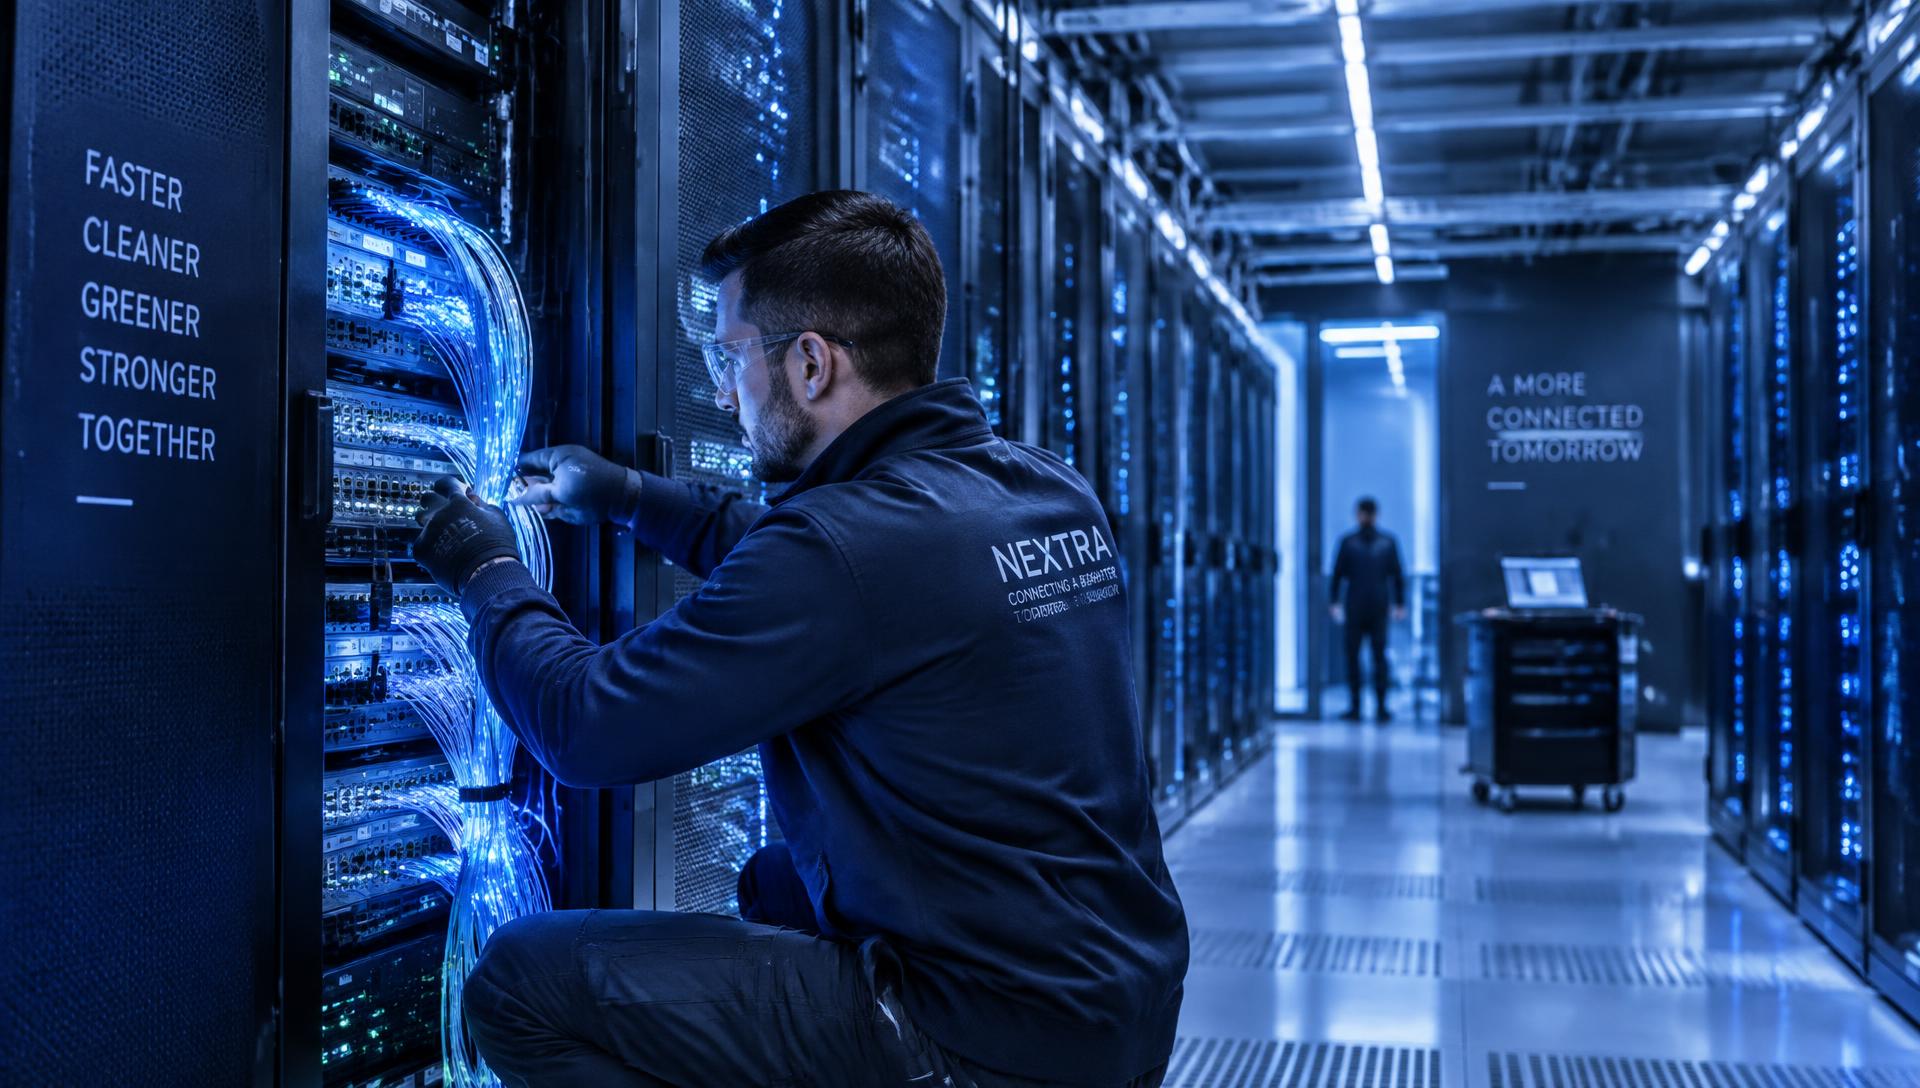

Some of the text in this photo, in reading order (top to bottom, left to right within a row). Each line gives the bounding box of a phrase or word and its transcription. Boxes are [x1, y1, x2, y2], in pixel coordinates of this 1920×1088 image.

[86, 149, 182, 212] FASTER
[83, 216, 200, 278] CLEANER
[81, 281, 200, 338] GREENER
[79, 346, 216, 400] STRONGER
[1487, 372, 1586, 397] A MORE
[78, 412, 215, 462] TOGETHER
[1487, 405, 1643, 430] CONNECTED
[1488, 438, 1643, 463] TOMORROW
[991, 526, 1112, 582] NEXTRA
[1008, 579, 1070, 606] CONNECTING
